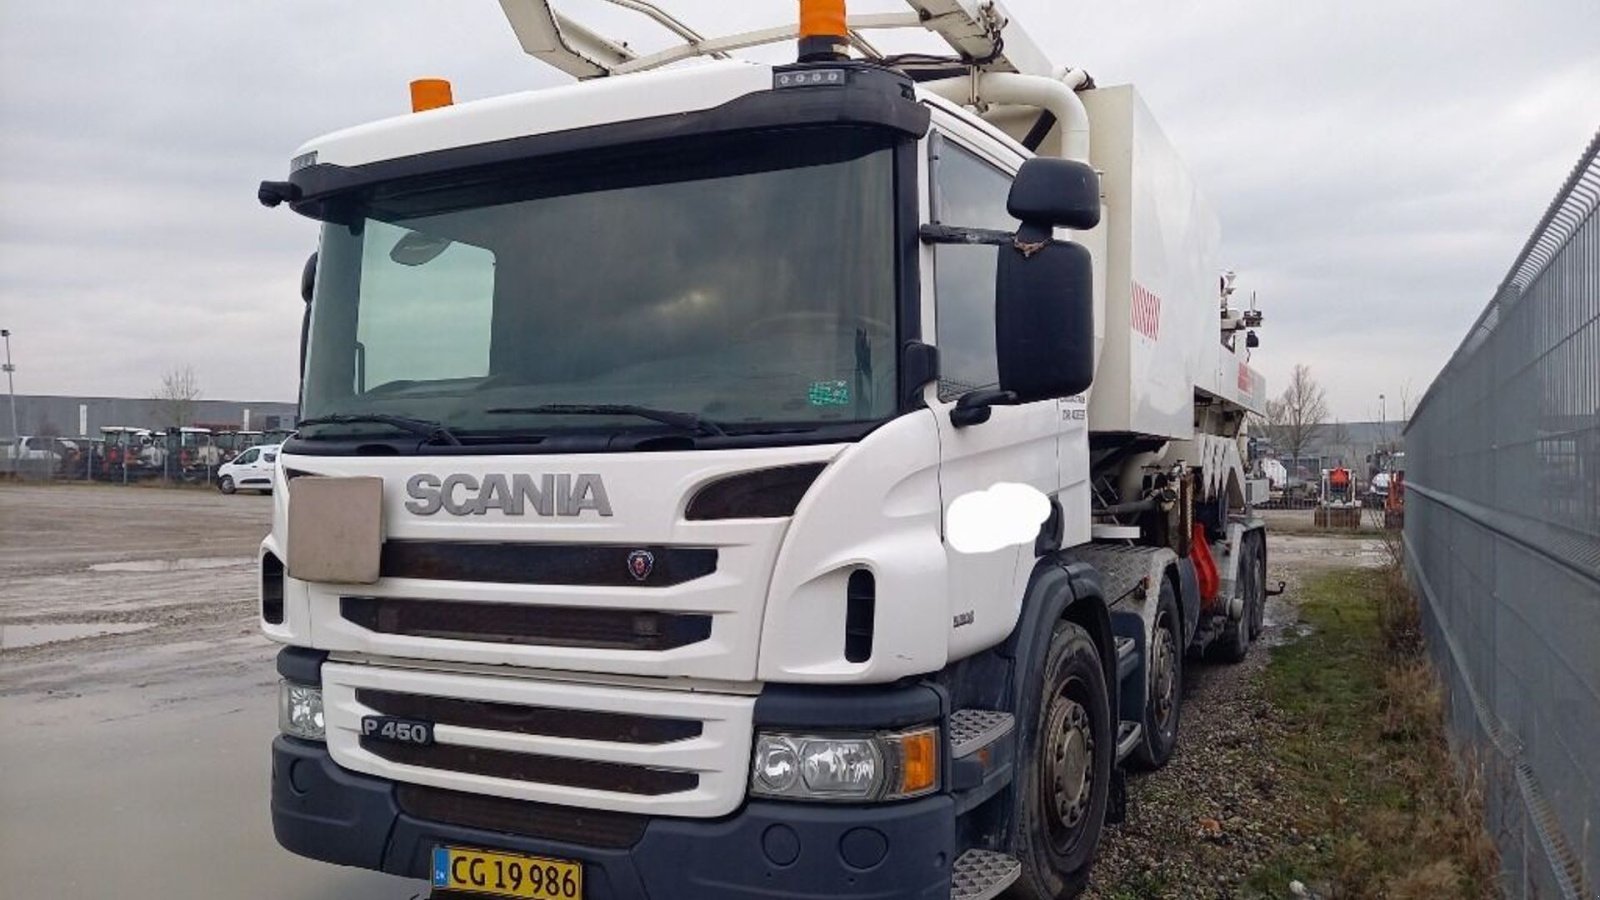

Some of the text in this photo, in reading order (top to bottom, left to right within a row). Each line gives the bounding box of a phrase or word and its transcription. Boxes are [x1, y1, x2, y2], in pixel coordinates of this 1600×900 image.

[404, 473, 614, 517] SCANIA
[363, 719, 426, 744] P 450
[452, 856, 576, 897] CG 19 986
